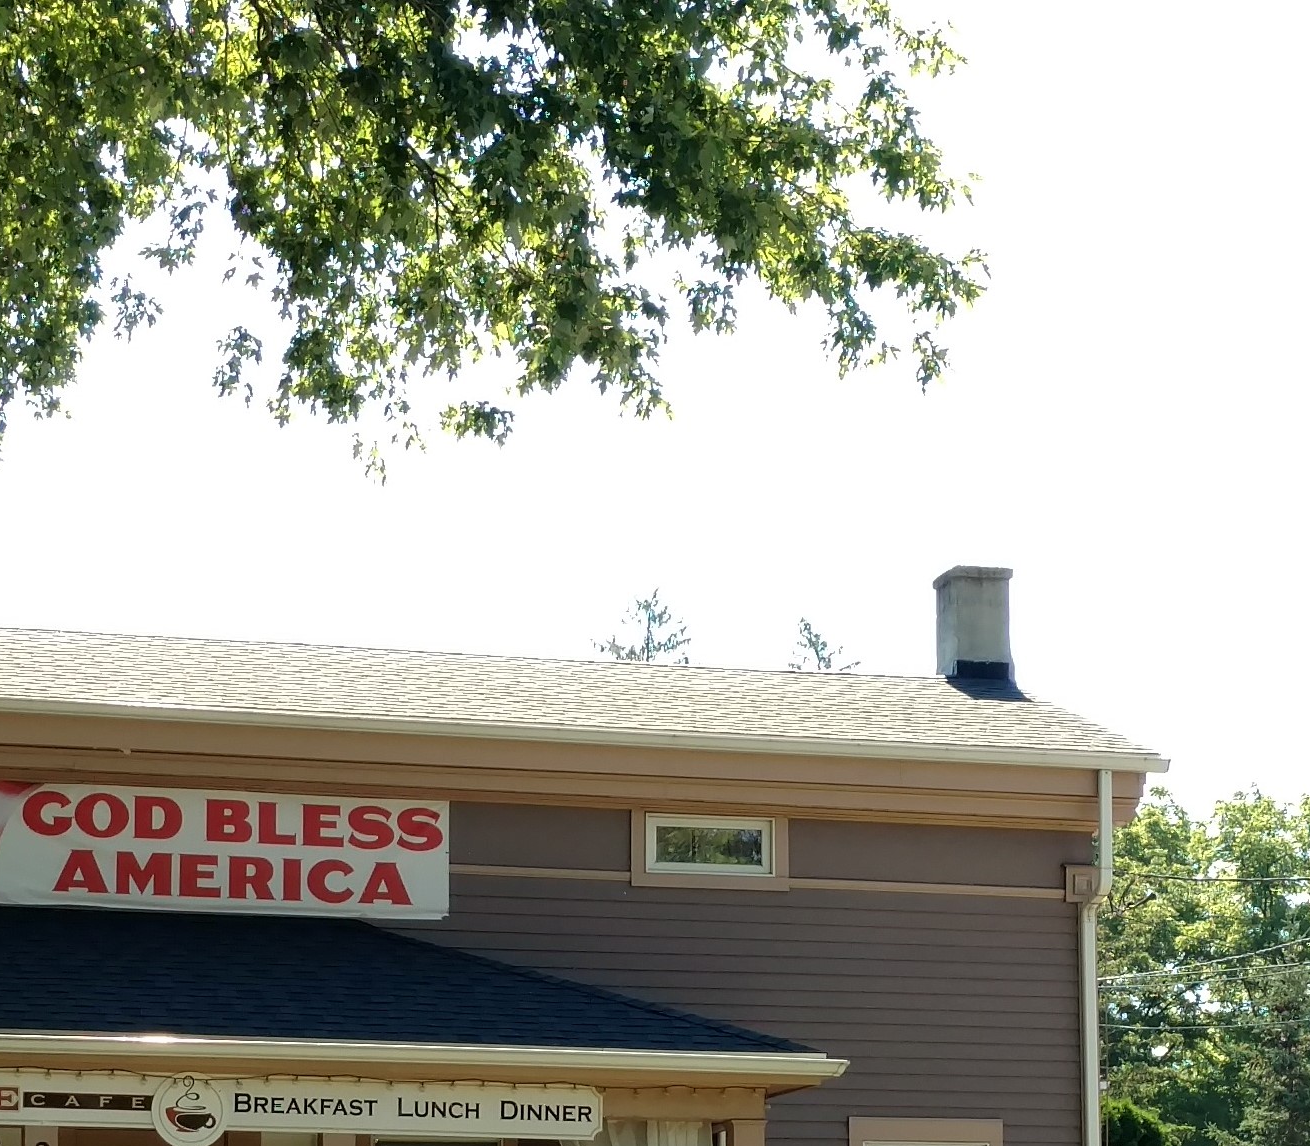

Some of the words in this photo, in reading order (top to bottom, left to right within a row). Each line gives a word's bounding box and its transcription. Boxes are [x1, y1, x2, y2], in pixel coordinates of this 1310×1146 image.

[22, 790, 183, 841] GOD
[205, 799, 444, 852] BLESS
[52, 849, 413, 906] AMERICA
[31, 1093, 146, 1109] CAFE
[233, 1092, 378, 1116] BREAKFAST
[397, 1098, 480, 1120] LUNCH
[500, 1100, 592, 1123] DINNER
